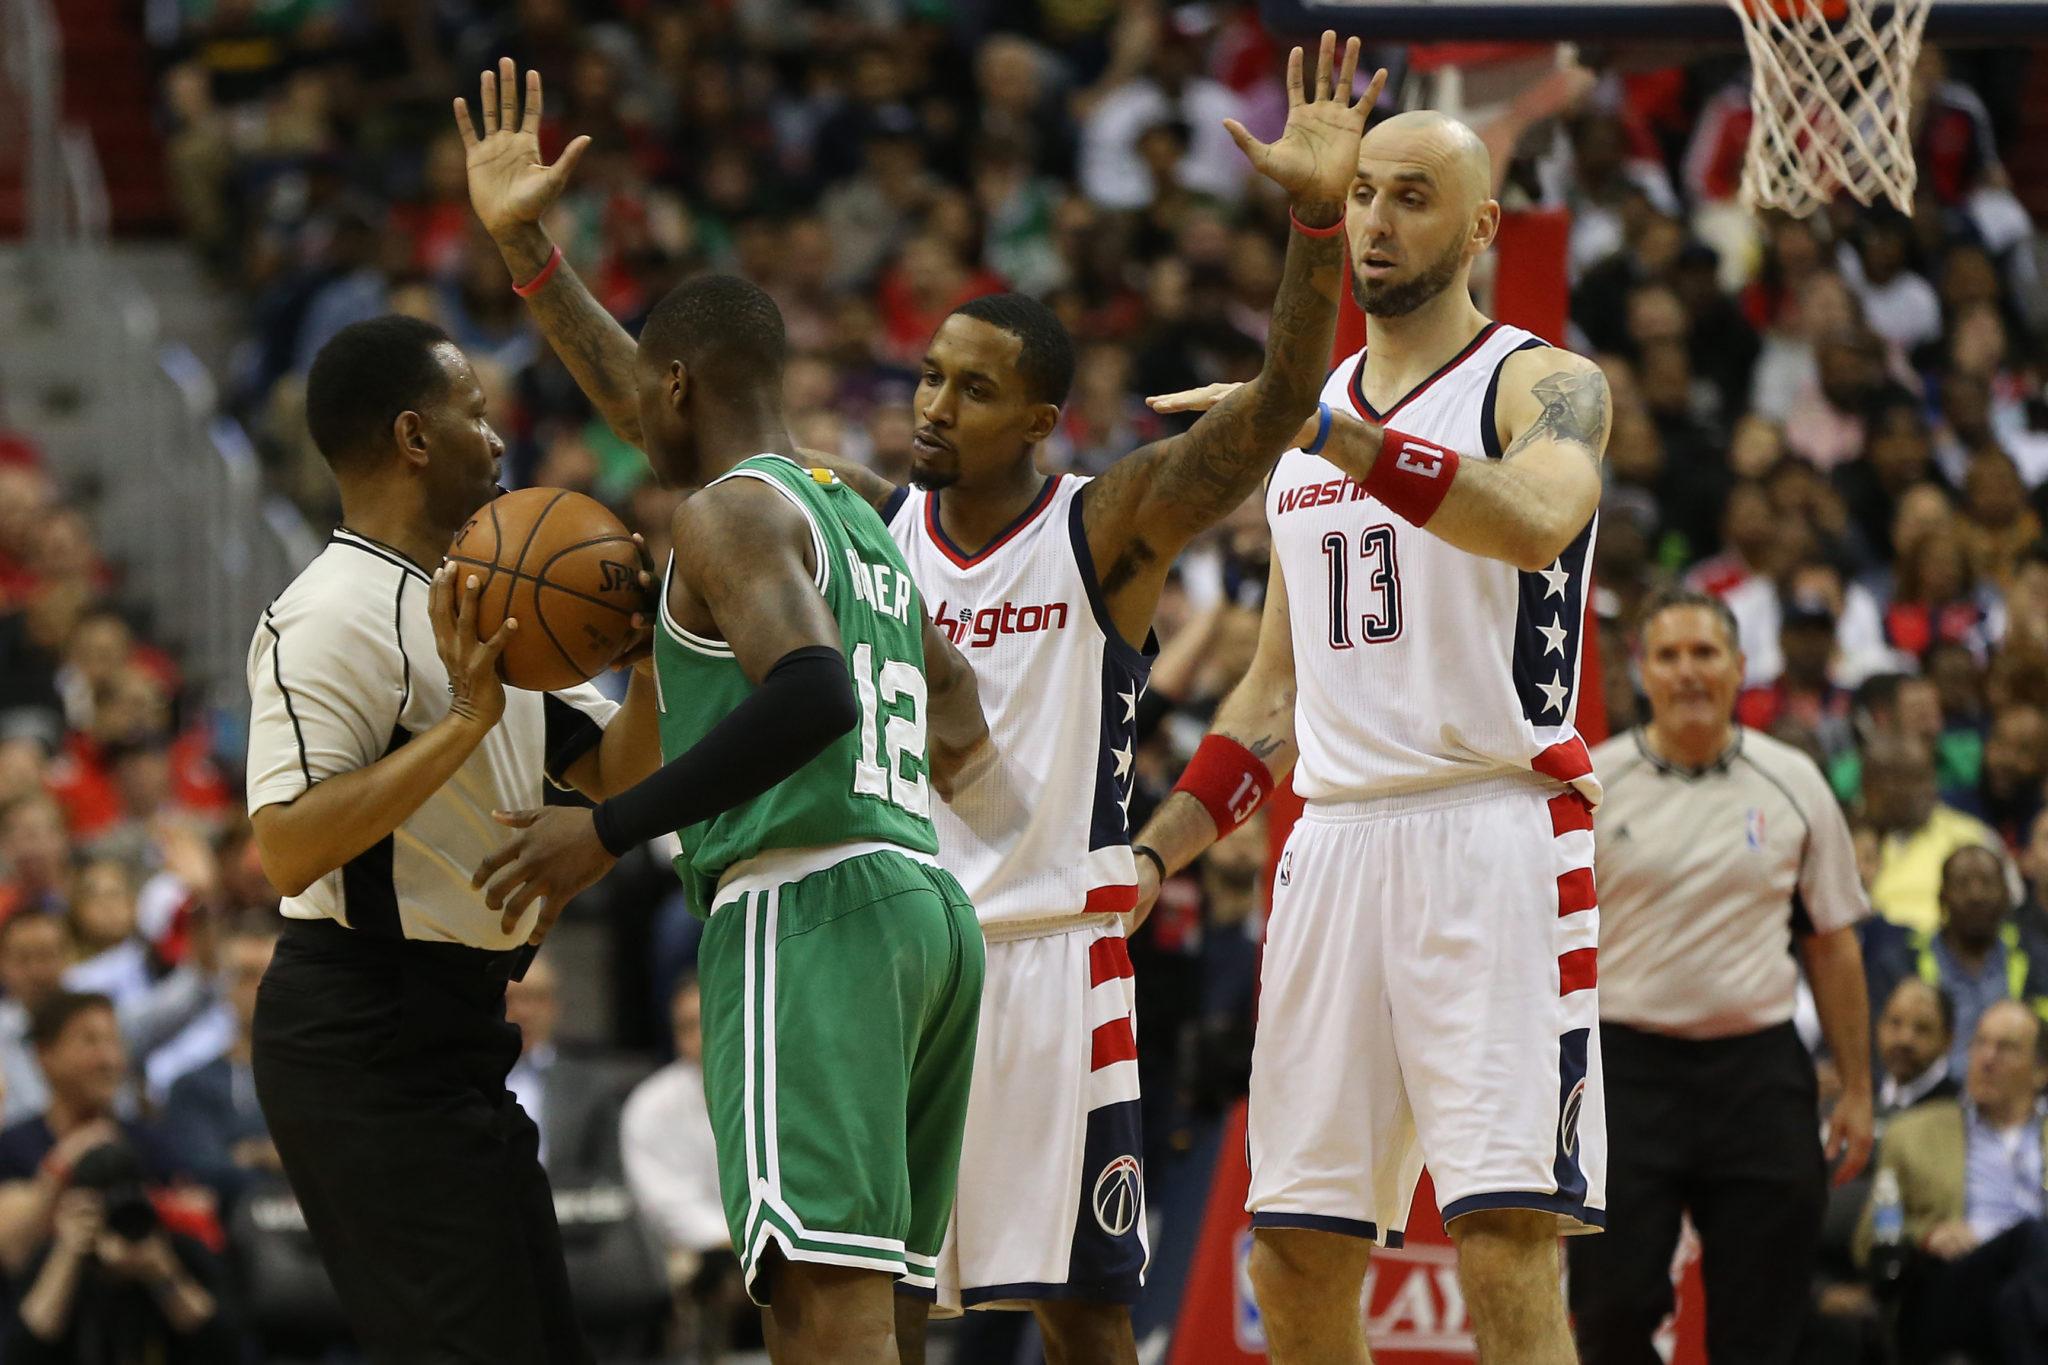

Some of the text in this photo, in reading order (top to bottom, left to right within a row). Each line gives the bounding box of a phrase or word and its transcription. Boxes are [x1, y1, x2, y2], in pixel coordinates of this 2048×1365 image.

[1396, 441, 1444, 479] 13
[1322, 523, 1403, 650] 13
[852, 642, 930, 820] 12
[1227, 771, 1261, 824] 13
